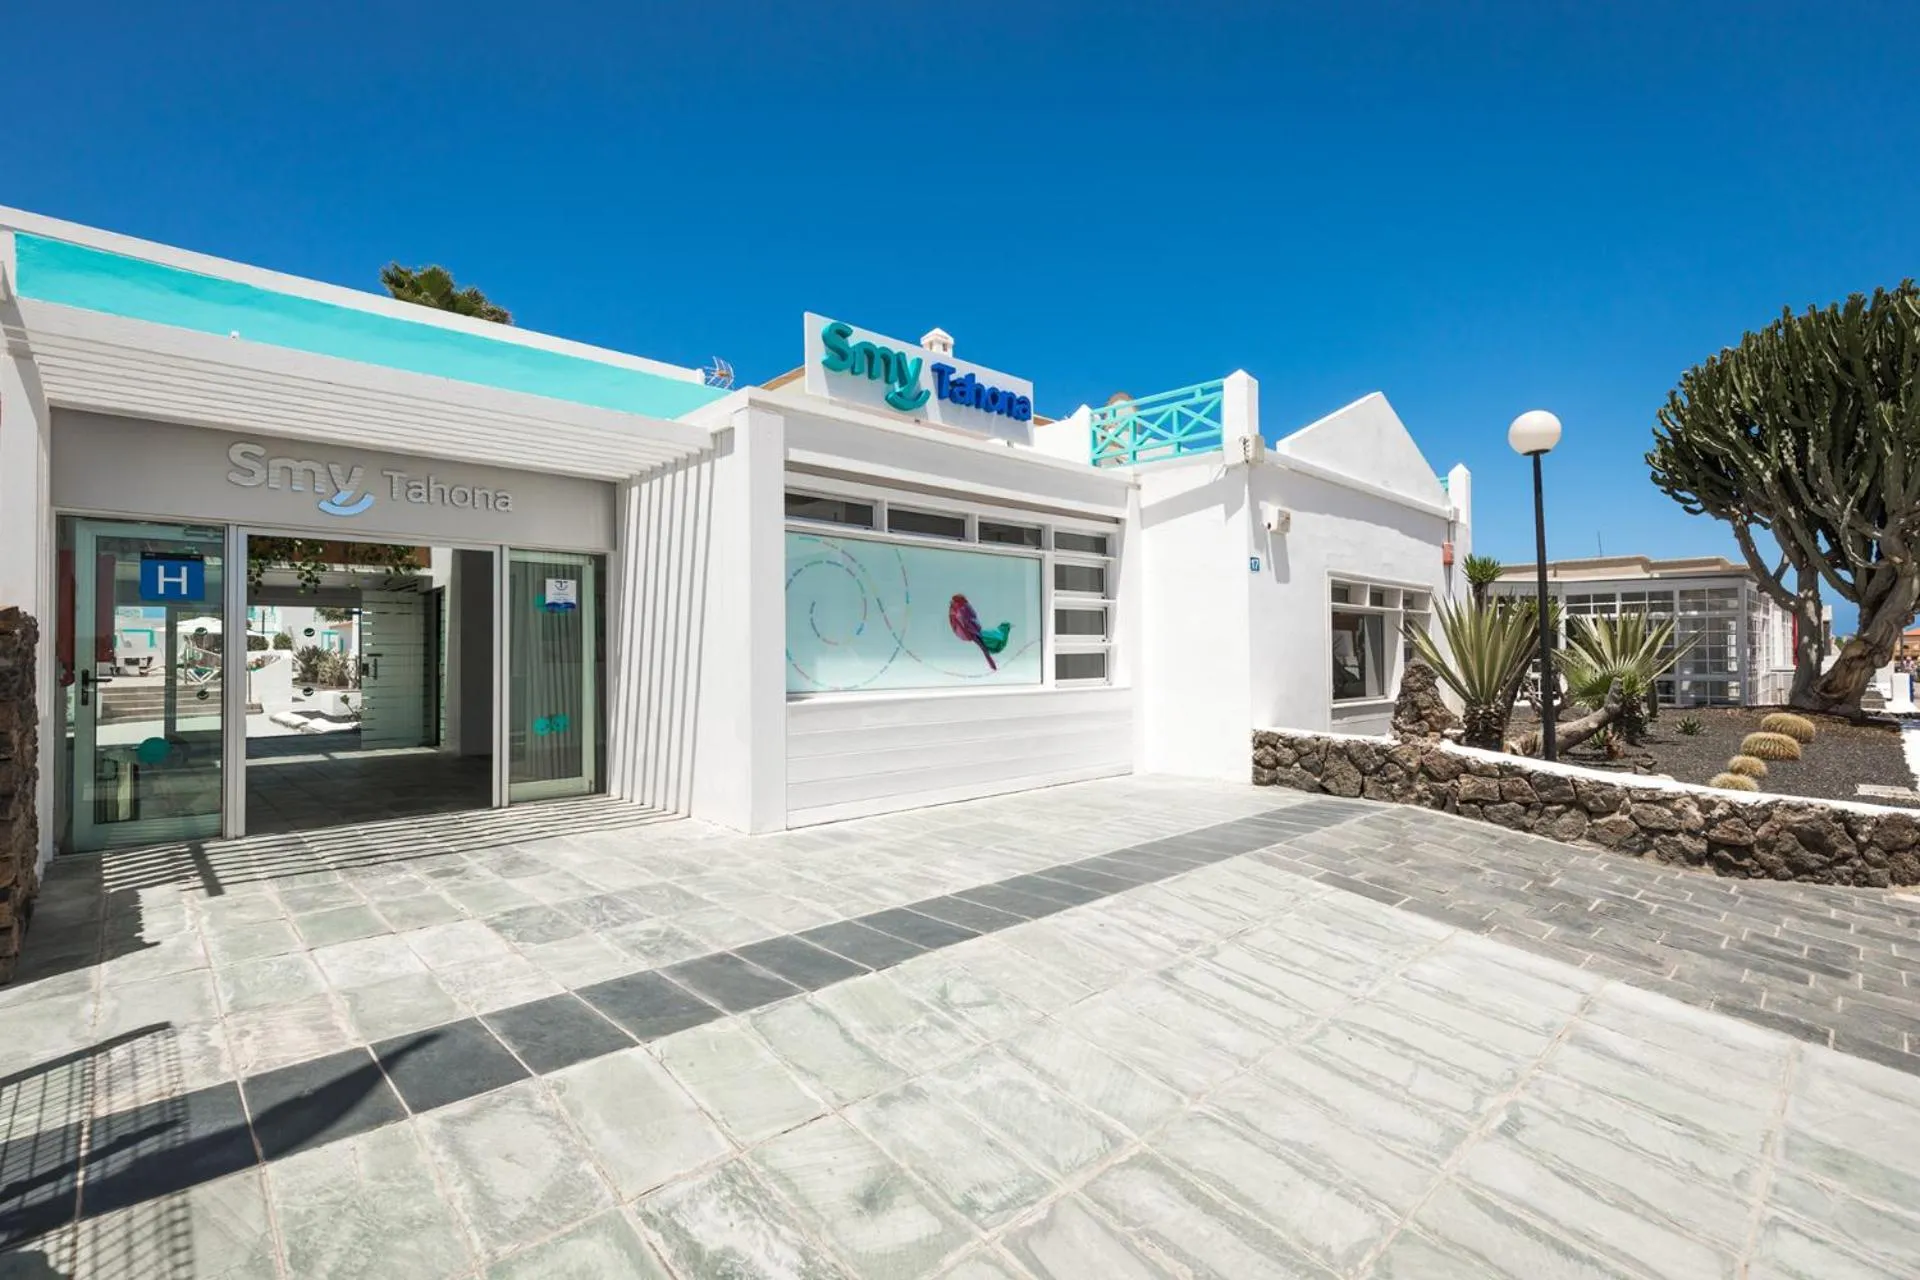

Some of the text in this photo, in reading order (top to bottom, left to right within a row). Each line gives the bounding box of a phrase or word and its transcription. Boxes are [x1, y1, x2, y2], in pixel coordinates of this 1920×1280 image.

[821, 322, 1032, 422] Smy Tahona
[227, 441, 513, 516] Smy Tahona
[158, 565, 187, 595] H
